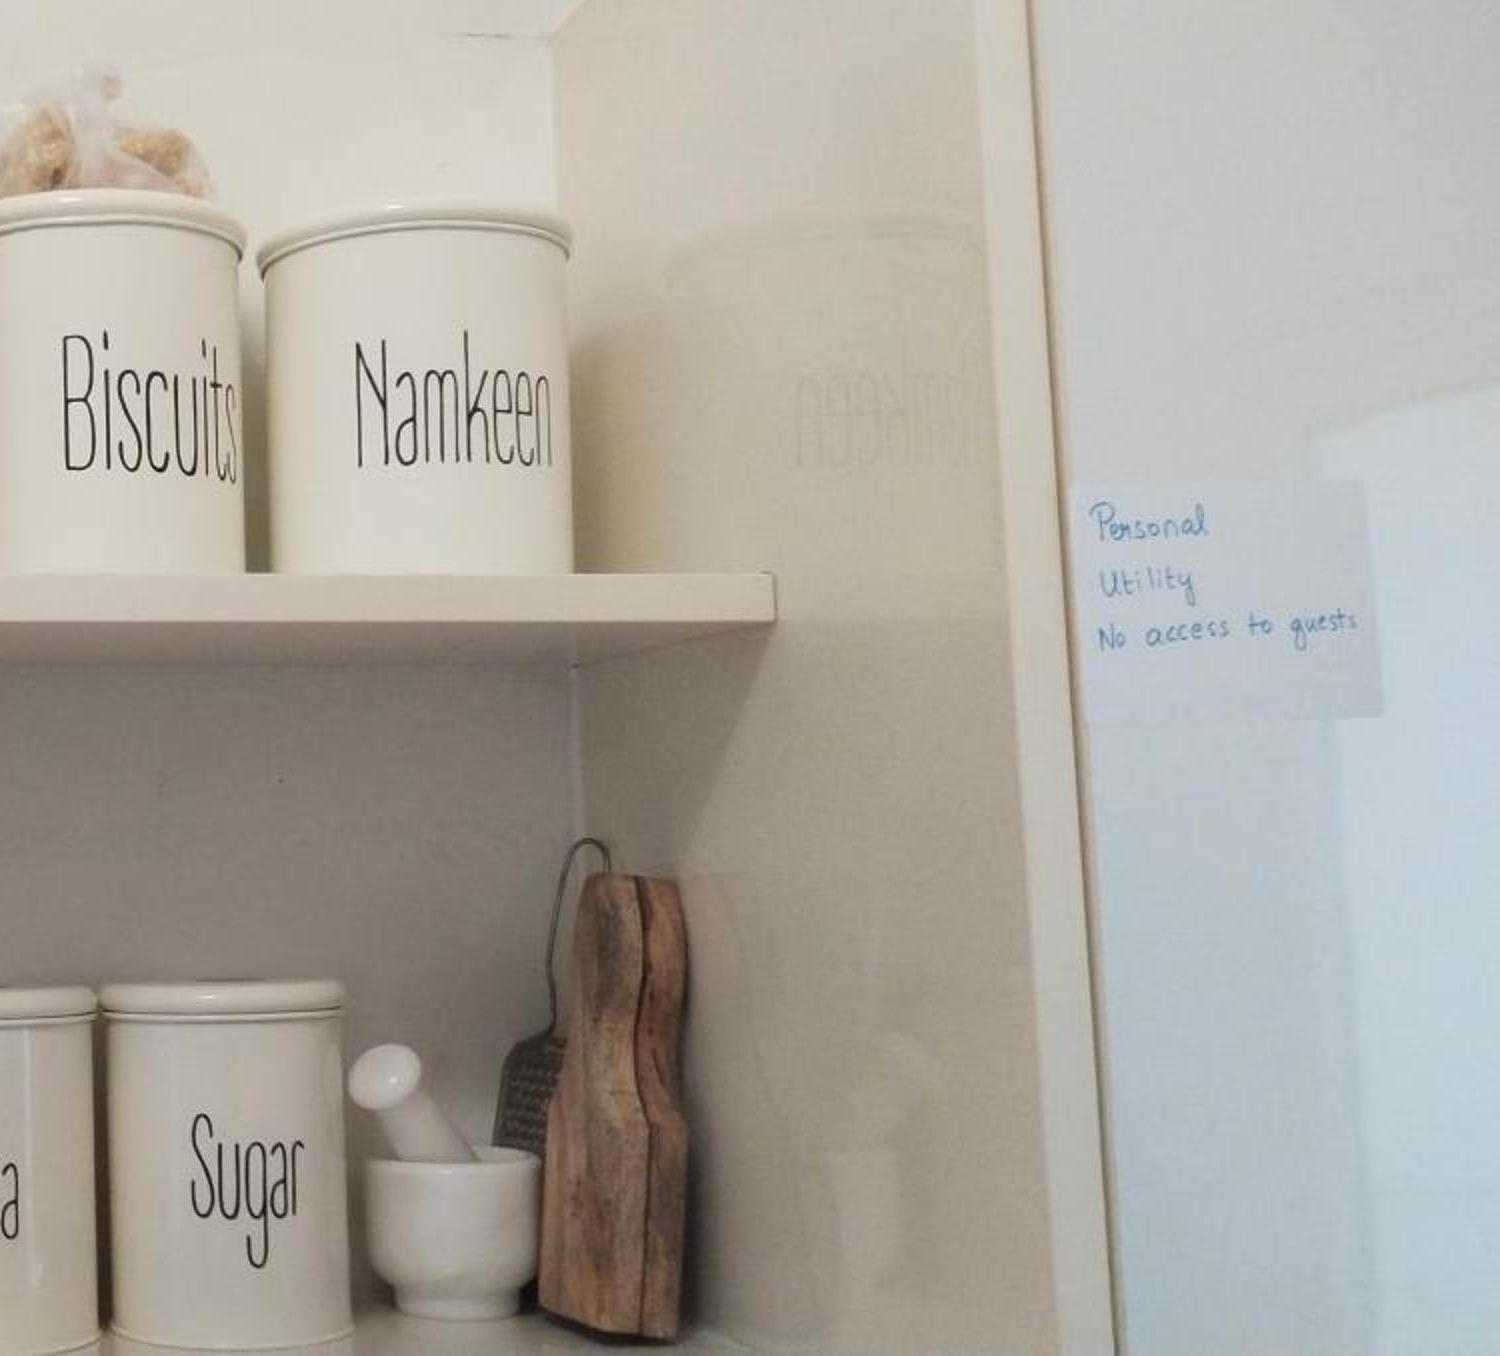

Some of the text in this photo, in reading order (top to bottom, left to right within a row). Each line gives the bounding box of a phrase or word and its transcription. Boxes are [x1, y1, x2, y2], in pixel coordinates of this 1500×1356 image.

[62, 330, 238, 484] Biscuits
[355, 330, 552, 468] Namkeen
[1088, 501, 1209, 542] Personal
[1099, 566, 1197, 606] Utility
[1099, 608, 1357, 651] No access to guests
[190, 1112, 306, 1269] Sugar
